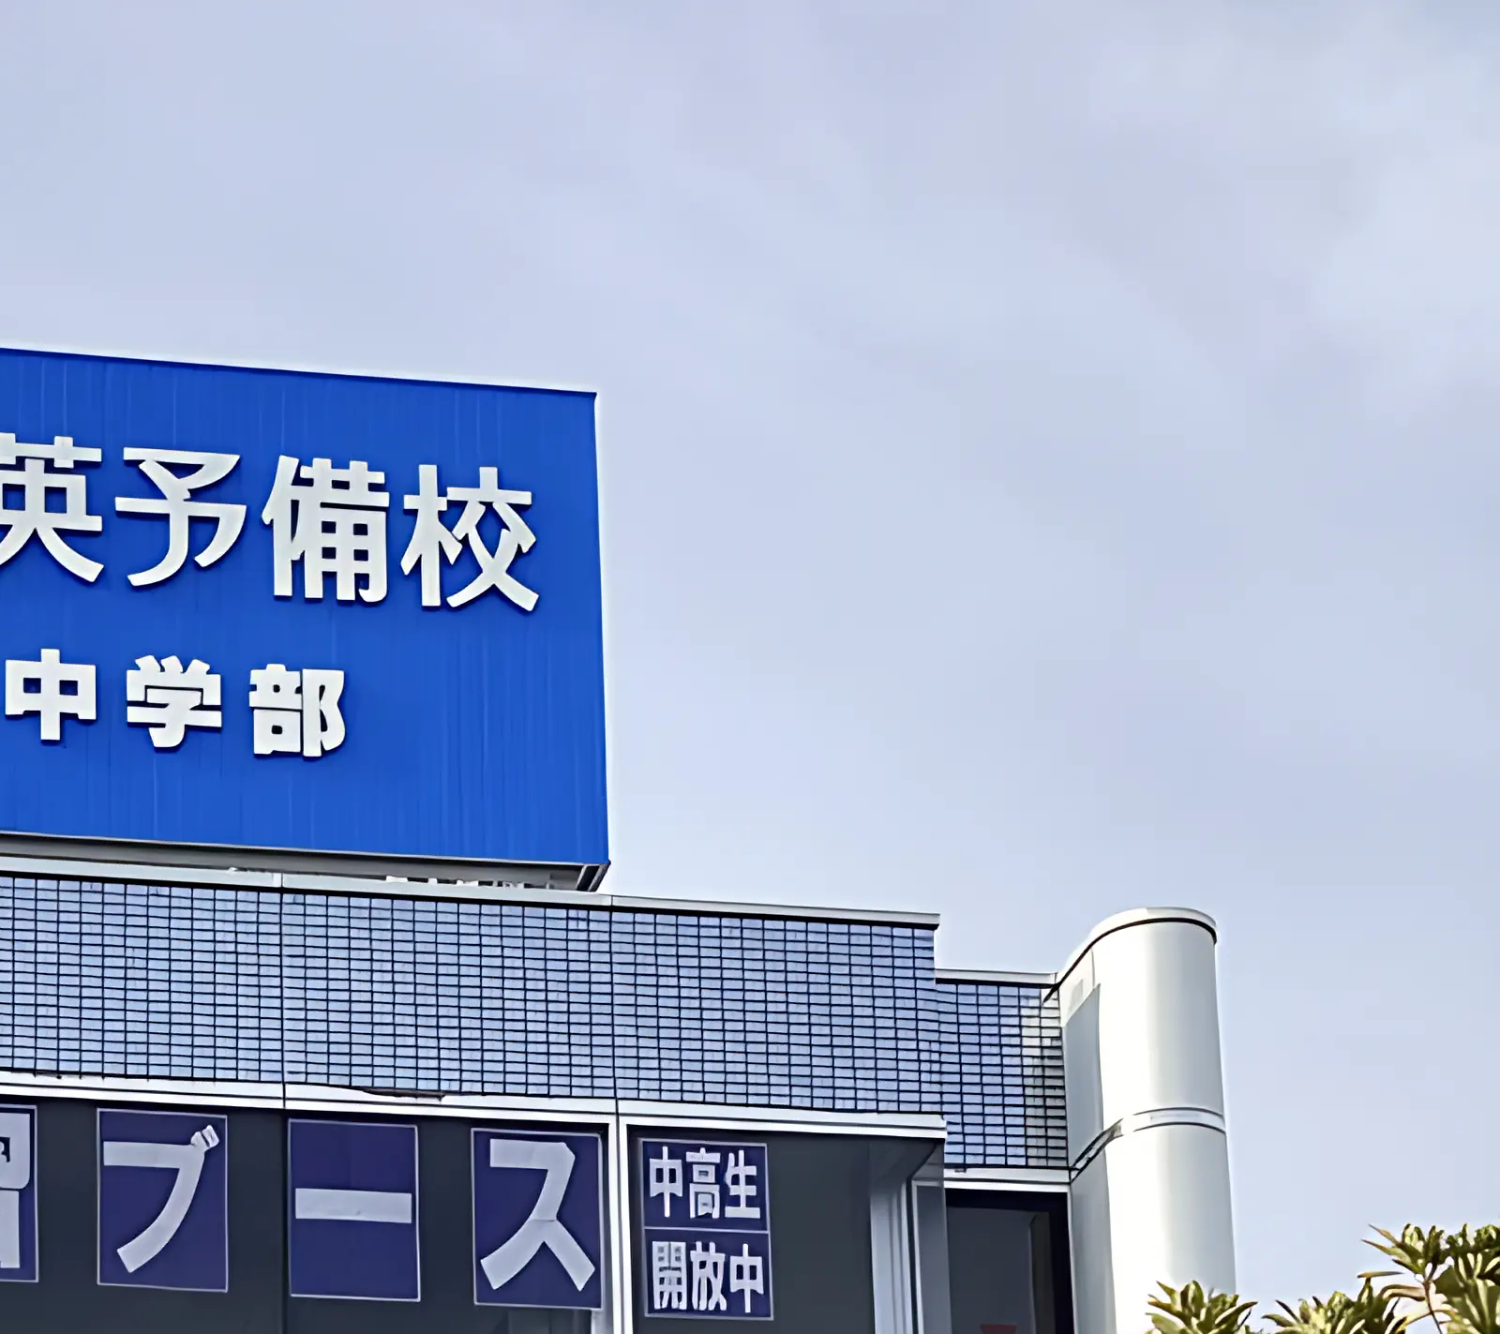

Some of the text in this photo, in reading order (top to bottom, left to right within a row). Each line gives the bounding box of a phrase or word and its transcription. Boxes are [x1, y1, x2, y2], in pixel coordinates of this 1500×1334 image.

[649, 1145, 762, 1222] 中高生
[652, 1240, 764, 1315] 開放中
